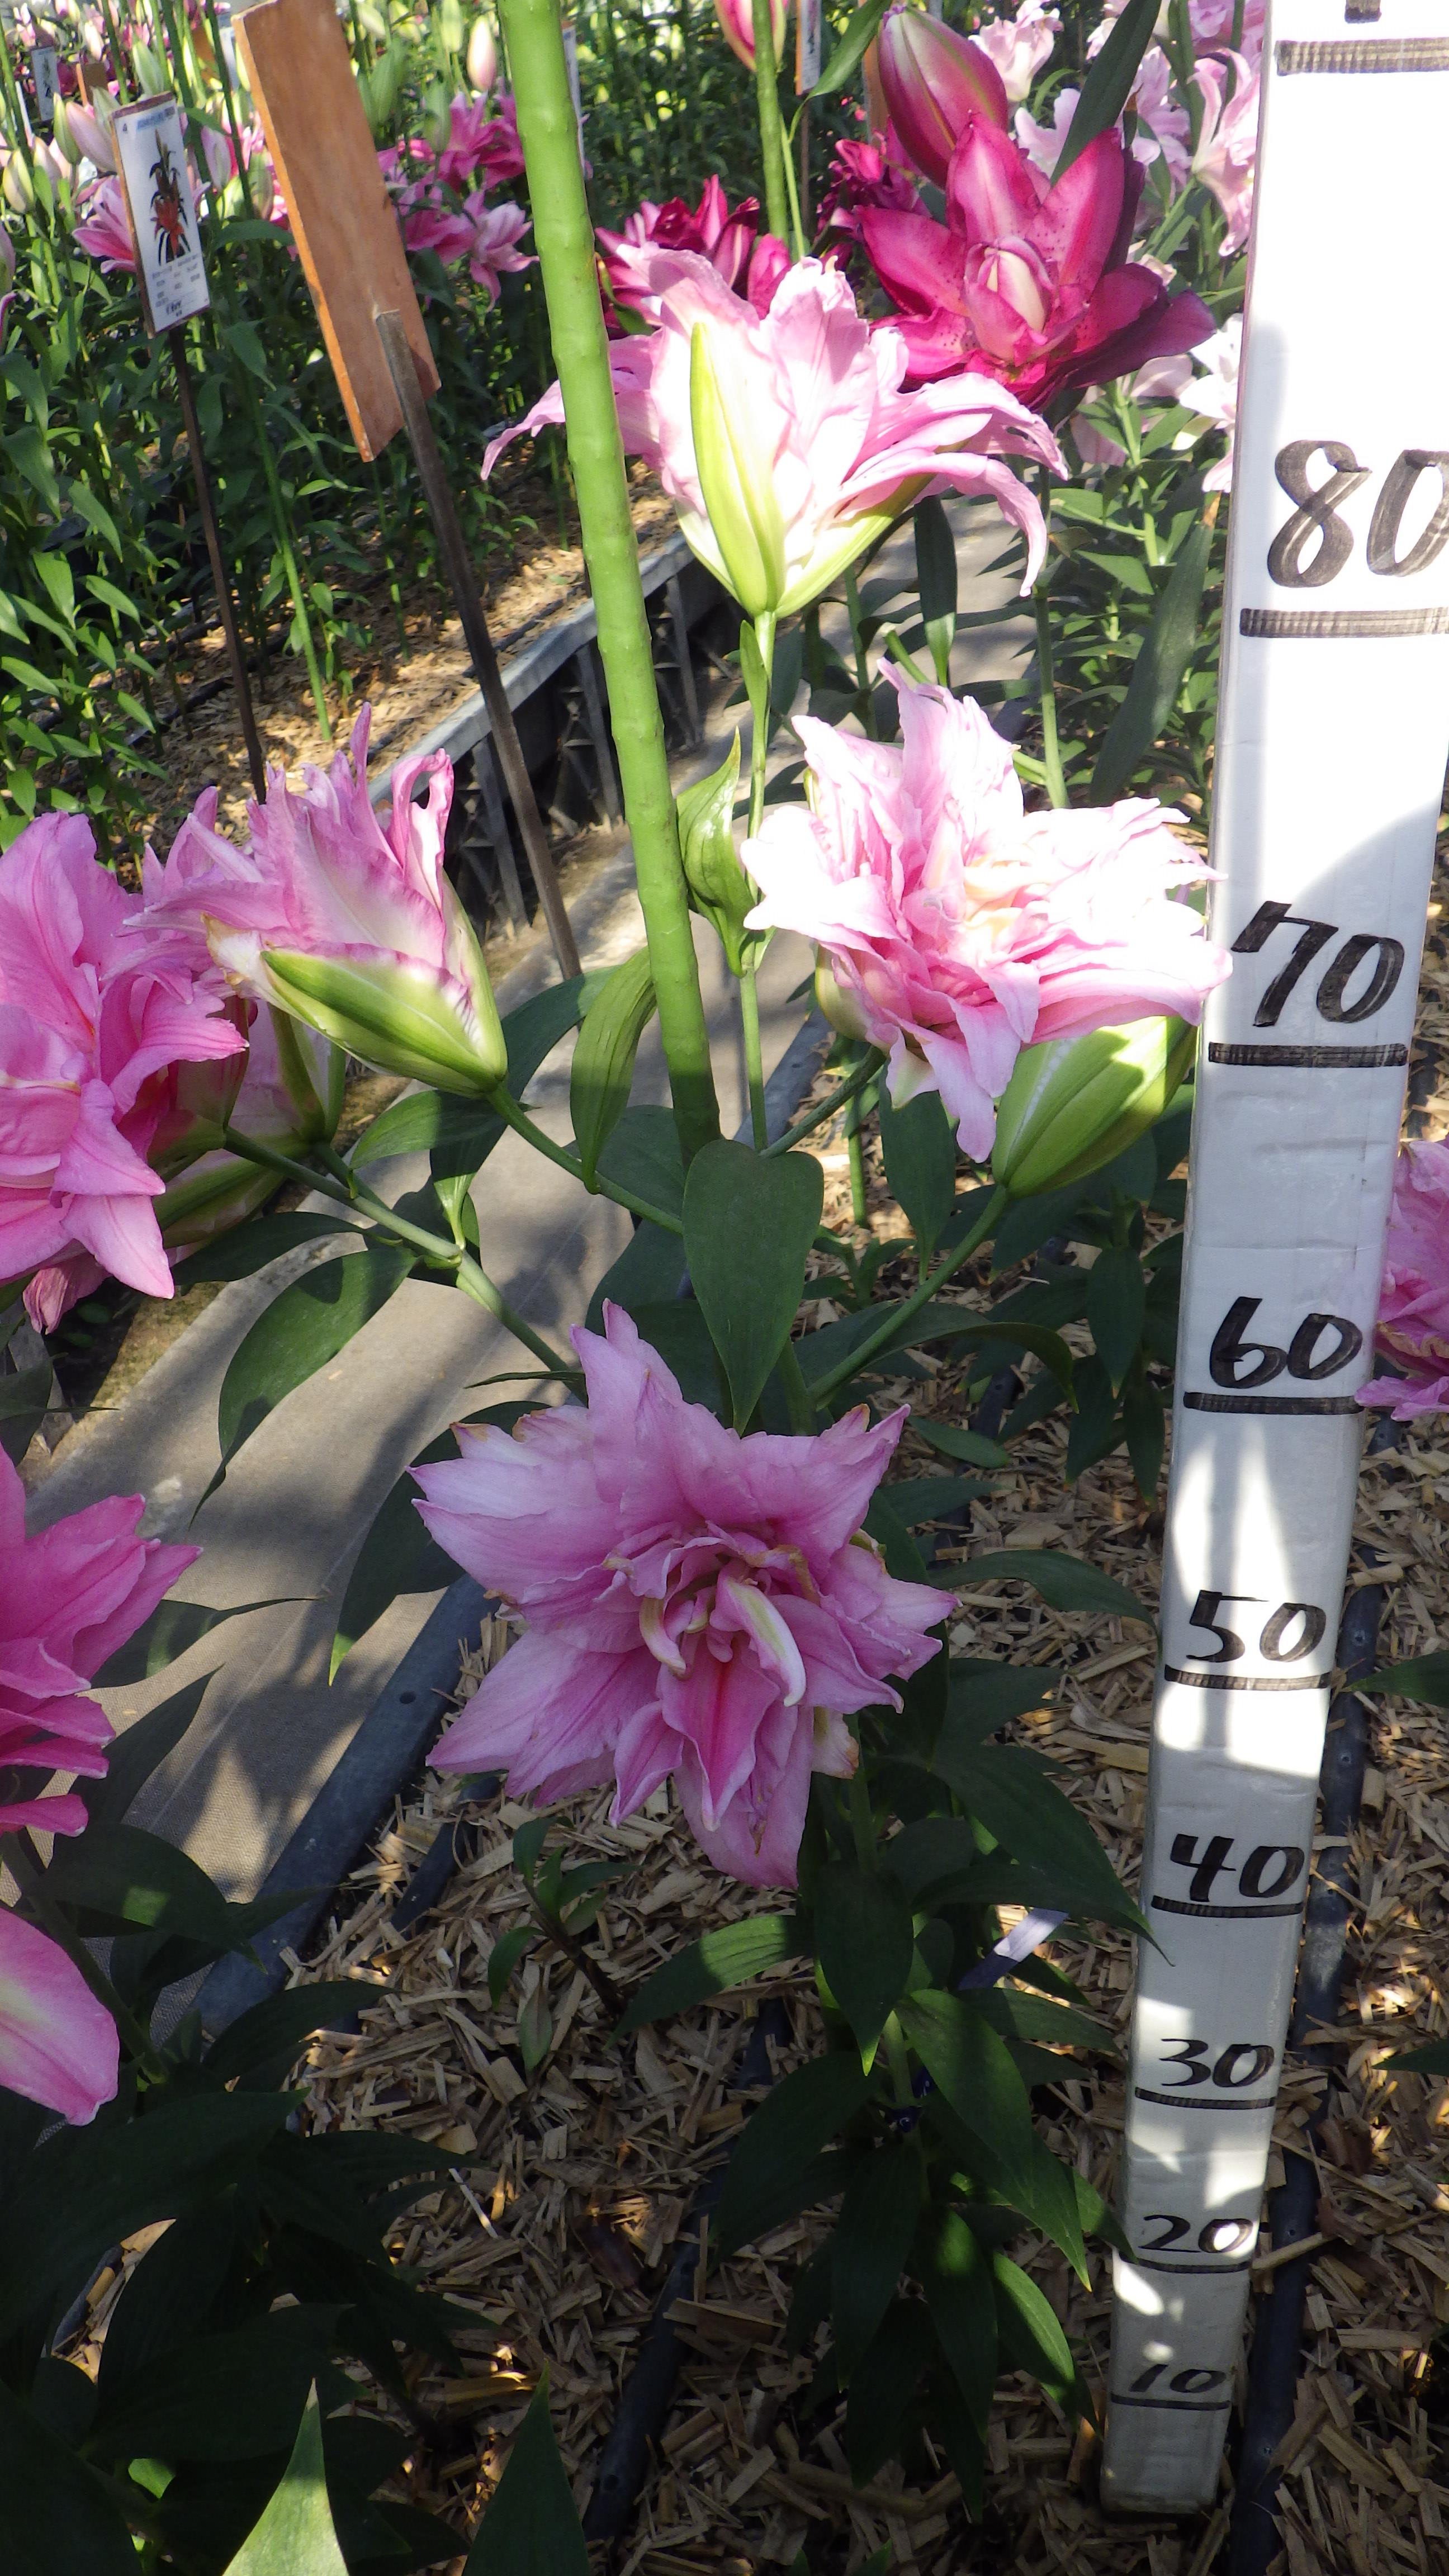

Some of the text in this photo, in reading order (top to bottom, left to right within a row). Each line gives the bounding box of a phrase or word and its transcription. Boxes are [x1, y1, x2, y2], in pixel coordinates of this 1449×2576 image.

[1267, 439, 1449, 588] 80
[1231, 901, 1404, 1027] 70
[1209, 1296, 1363, 1389] 60
[1186, 1590, 1326, 1663] 50
[1170, 1834, 1305, 1902] 40
[1159, 2038, 1275, 2087] 30
[1138, 2215, 1253, 2253] 20
[1129, 2364, 1227, 2393] 10
